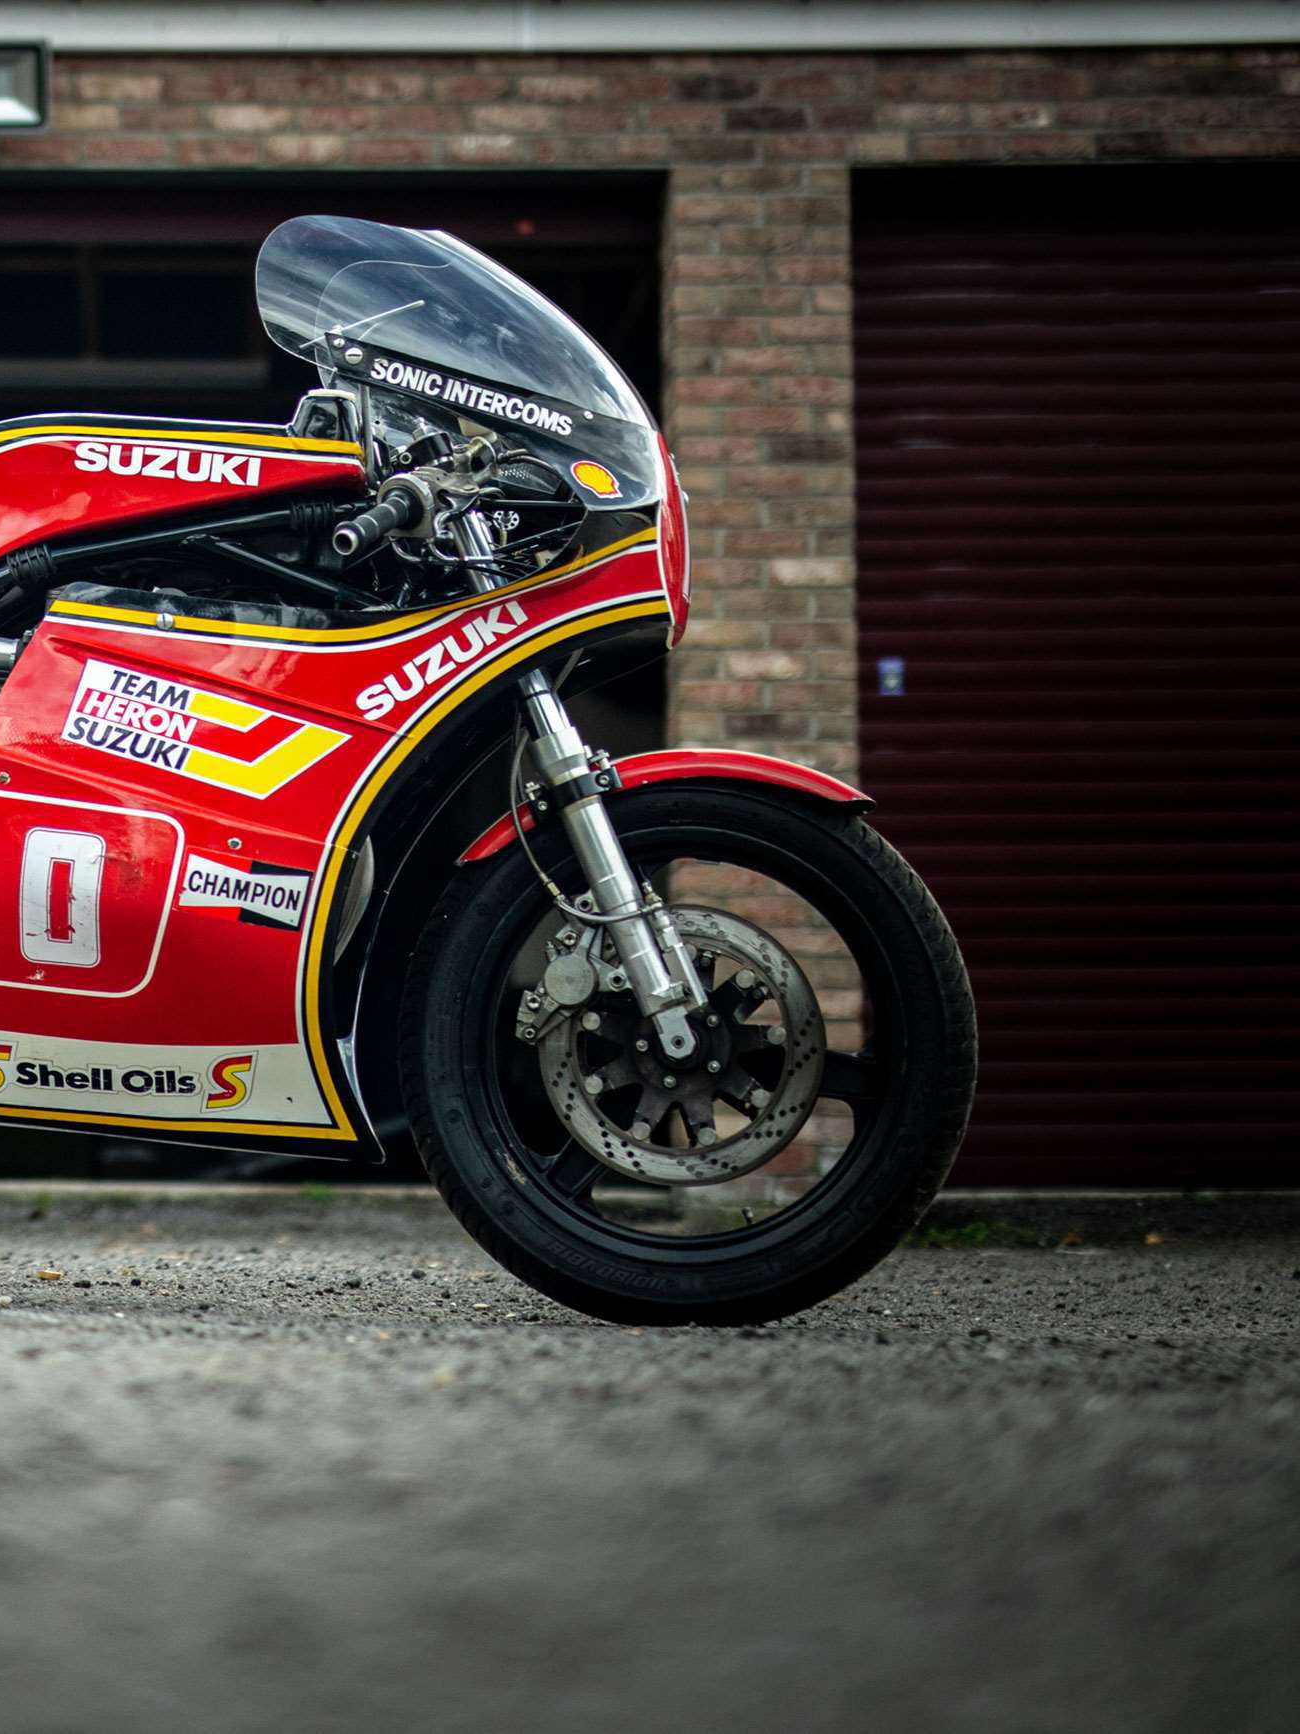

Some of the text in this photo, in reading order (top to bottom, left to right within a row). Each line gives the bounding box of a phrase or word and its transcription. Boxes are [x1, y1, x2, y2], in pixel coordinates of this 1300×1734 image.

[371, 358, 573, 436] SONIC INTERCOMS
[73, 441, 262, 487] SUZUKI
[355, 600, 529, 722] SUZUKI
[110, 670, 190, 710] TEAM
[81, 690, 198, 742] HERON
[68, 717, 190, 770] SUZUKI
[188, 870, 300, 911] CHAMPION
[16, 1061, 113, 1092] Shell
[121, 1068, 197, 1095] Oils
